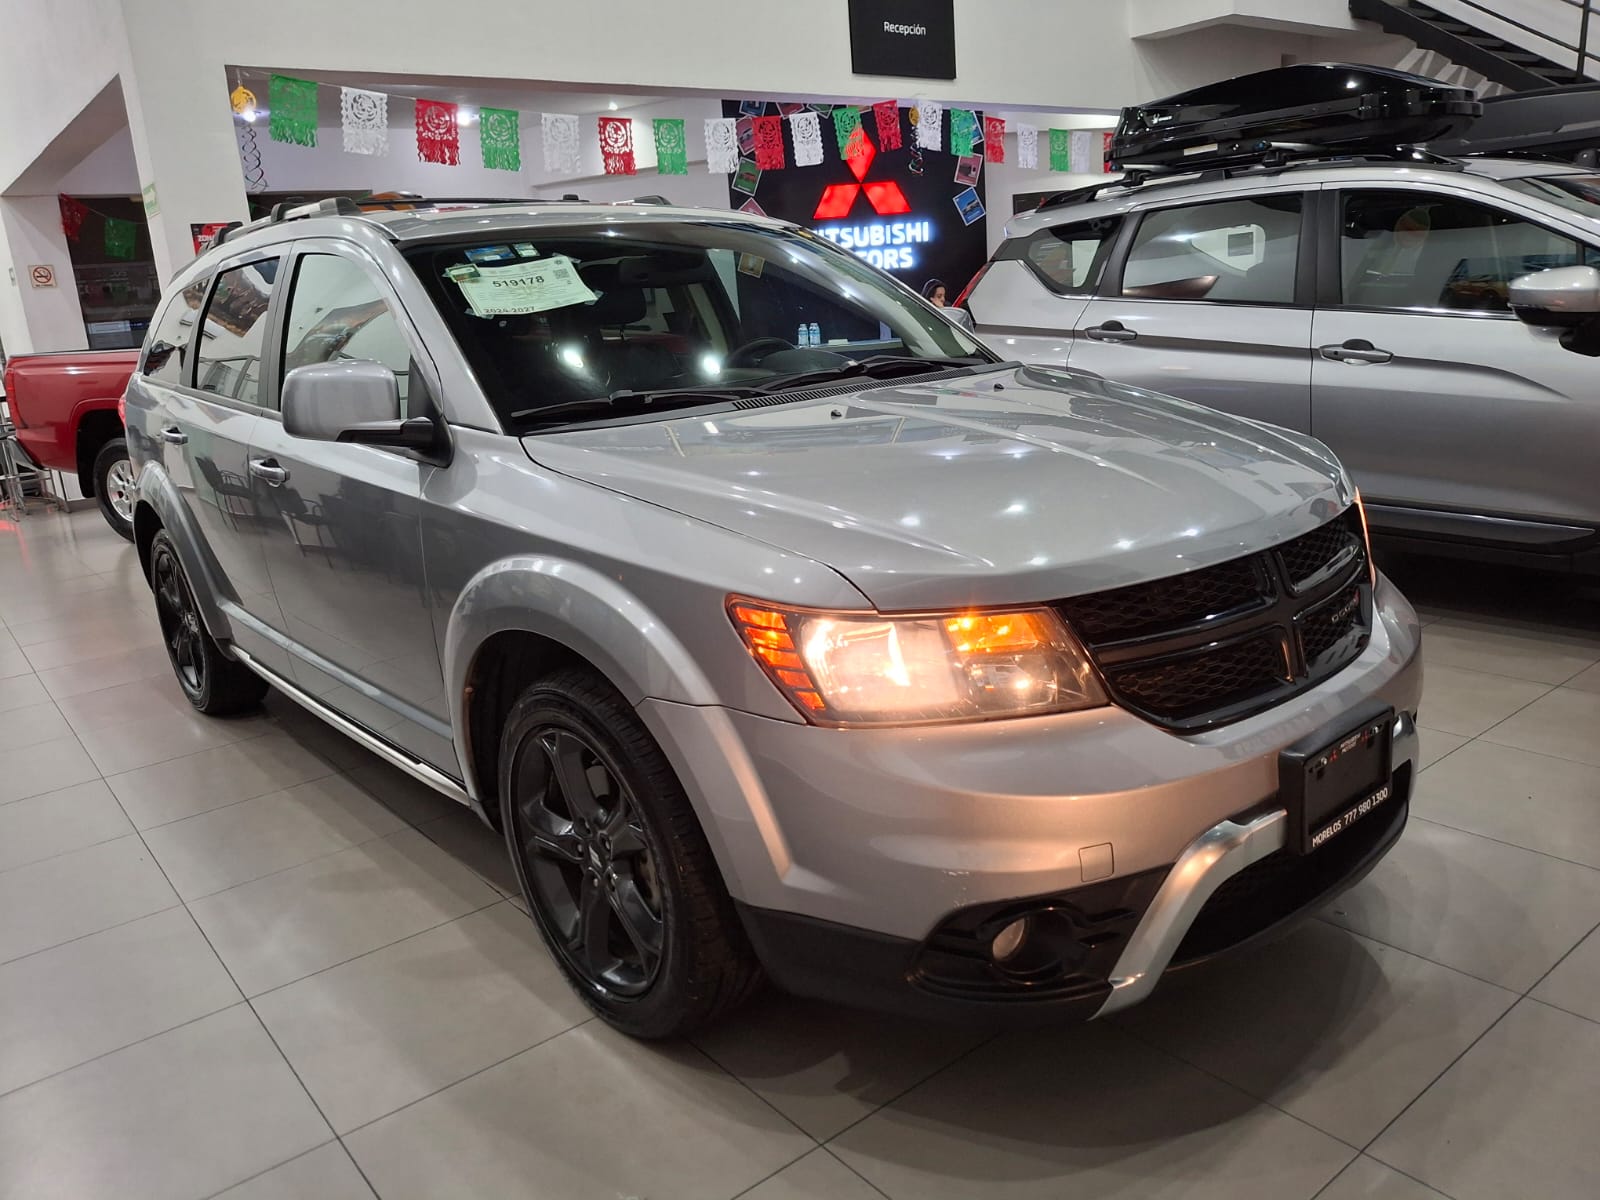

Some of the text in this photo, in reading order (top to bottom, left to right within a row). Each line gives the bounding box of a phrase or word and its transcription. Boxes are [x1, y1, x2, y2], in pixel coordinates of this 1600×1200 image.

[883, 21, 926, 36] Recepción
[812, 221, 929, 249] TSUBISHI
[855, 247, 913, 270] TORS
[492, 275, 545, 288] 519178
[1312, 787, 1388, 848] MORELOS 777 980 1300
